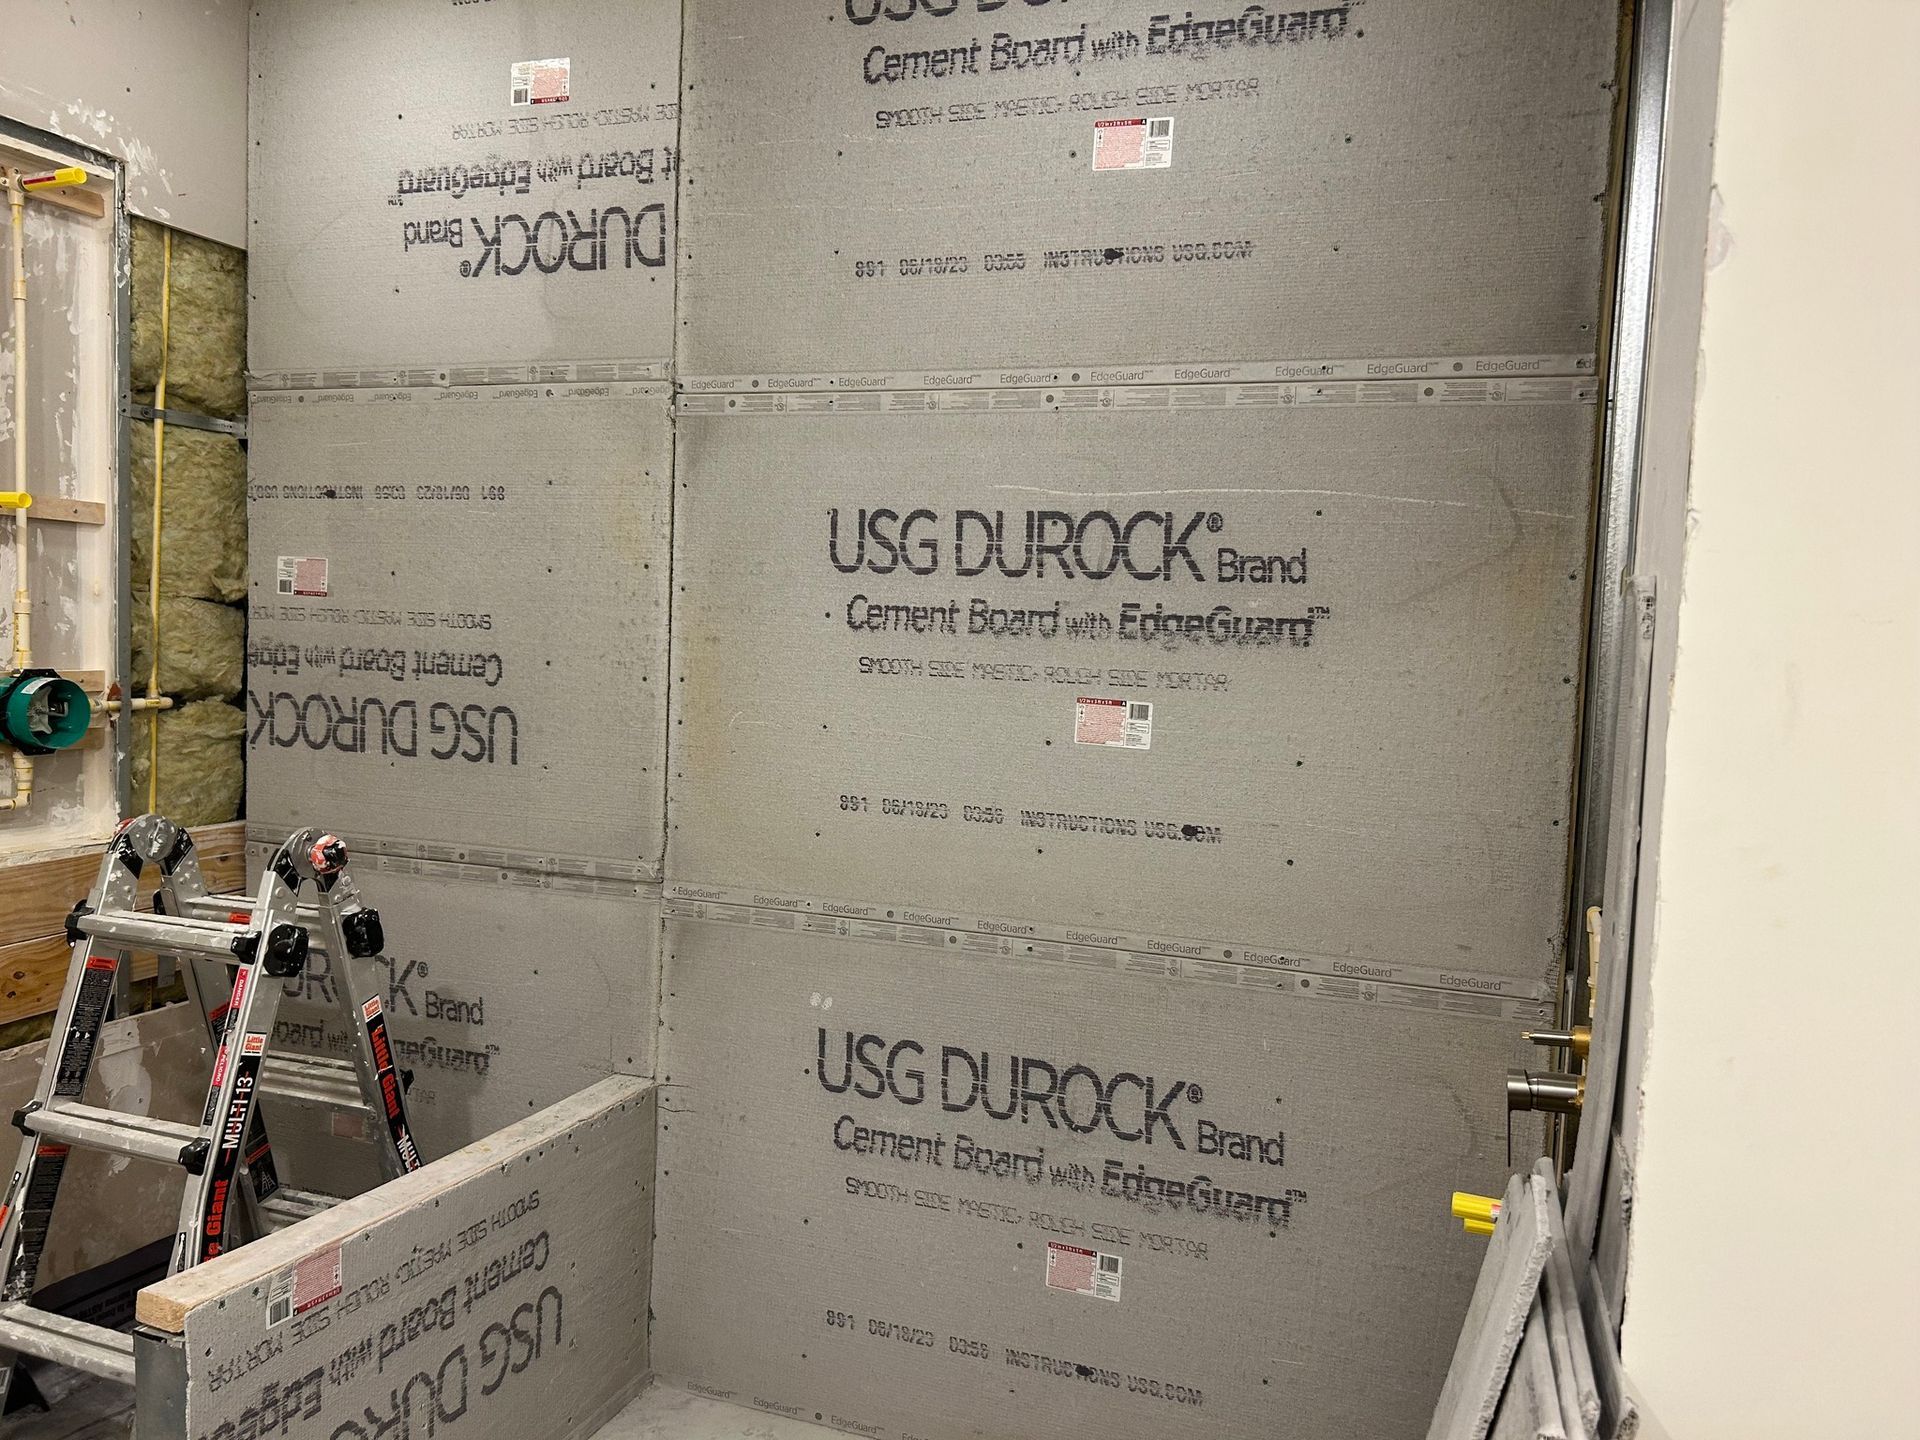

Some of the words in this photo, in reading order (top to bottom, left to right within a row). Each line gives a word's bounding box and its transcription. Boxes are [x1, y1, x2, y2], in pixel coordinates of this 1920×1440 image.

[863, 38, 982, 84] Cement
[989, 24, 1087, 70] Board
[1091, 30, 1140, 61] with
[542, 111, 589, 129] ROUGH
[876, 107, 943, 128] SMOOTH
[948, 102, 989, 122] SIDE
[1069, 90, 1129, 112] ROUGH
[1136, 85, 1178, 105] SIDE
[1185, 78, 1261, 101] MORTAR
[452, 121, 502, 141] MORTAR
[508, 116, 539, 134] SIDE
[536, 158, 574, 183] with
[577, 148, 654, 189] Board
[403, 218, 463, 252] Brand
[855, 259, 887, 278] 891
[1171, 241, 1255, 262] USG.COM
[829, 508, 939, 575] USG
[1217, 547, 1307, 584] Brand
[279, 607, 306, 622] SIDE
[311, 608, 350, 624] ROUGH
[407, 611, 436, 627] SIDE
[439, 613, 492, 630] SMOOTH
[847, 594, 960, 633] Cement
[968, 597, 1060, 639] Board
[1065, 611, 1112, 640] with
[305, 645, 336, 668] with
[340, 648, 406, 681] Board
[412, 651, 503, 687] Cement
[858, 656, 923, 676] SMOOTH
[927, 660, 967, 678] SIDE
[1043, 665, 1101, 685] ROUGH
[1108, 668, 1149, 687] SIDE
[1156, 671, 1230, 692] MORTAR
[430, 702, 518, 765] USG
[840, 794, 869, 813] 891
[1020, 809, 1138, 836] INSTRUCTIONS
[425, 990, 485, 1026] Brand
[245, 1043, 262, 1051] Giant
[247, 1035, 263, 1043] Little
[272, 1019, 325, 1049] oard
[235, 1076, 253, 1095] 13
[371, 1025, 389, 1071] Little
[382, 1073, 401, 1119] Giant
[817, 1027, 925, 1105] USG
[1198, 1119, 1285, 1167] Brand
[222, 1099, 249, 1149] MULTI
[833, 1114, 945, 1166] Cement
[954, 1133, 1044, 1184] Board
[1049, 1162, 1095, 1192] with
[206, 1179, 229, 1236] Giant
[490, 1189, 540, 1230] SMOOTH
[845, 1176, 909, 1203] SMOOTH
[914, 1189, 951, 1211] SIDE
[1028, 1210, 1085, 1237] ROUGH
[1091, 1223, 1134, 1246] SIDE
[1139, 1231, 1209, 1261] MORTAR
[457, 1219, 488, 1251] SIDE
[463, 1230, 550, 1313] Cement
[338, 1276, 391, 1315] ROUGH
[290, 1305, 331, 1346] SIDE
[377, 1284, 457, 1374] Board
[479, 1285, 563, 1396] USG
[208, 1331, 283, 1393] MORTAR
[328, 1334, 373, 1386] with
[826, 1309, 856, 1331] 891
[1126, 1374, 1205, 1407] USG.COM
